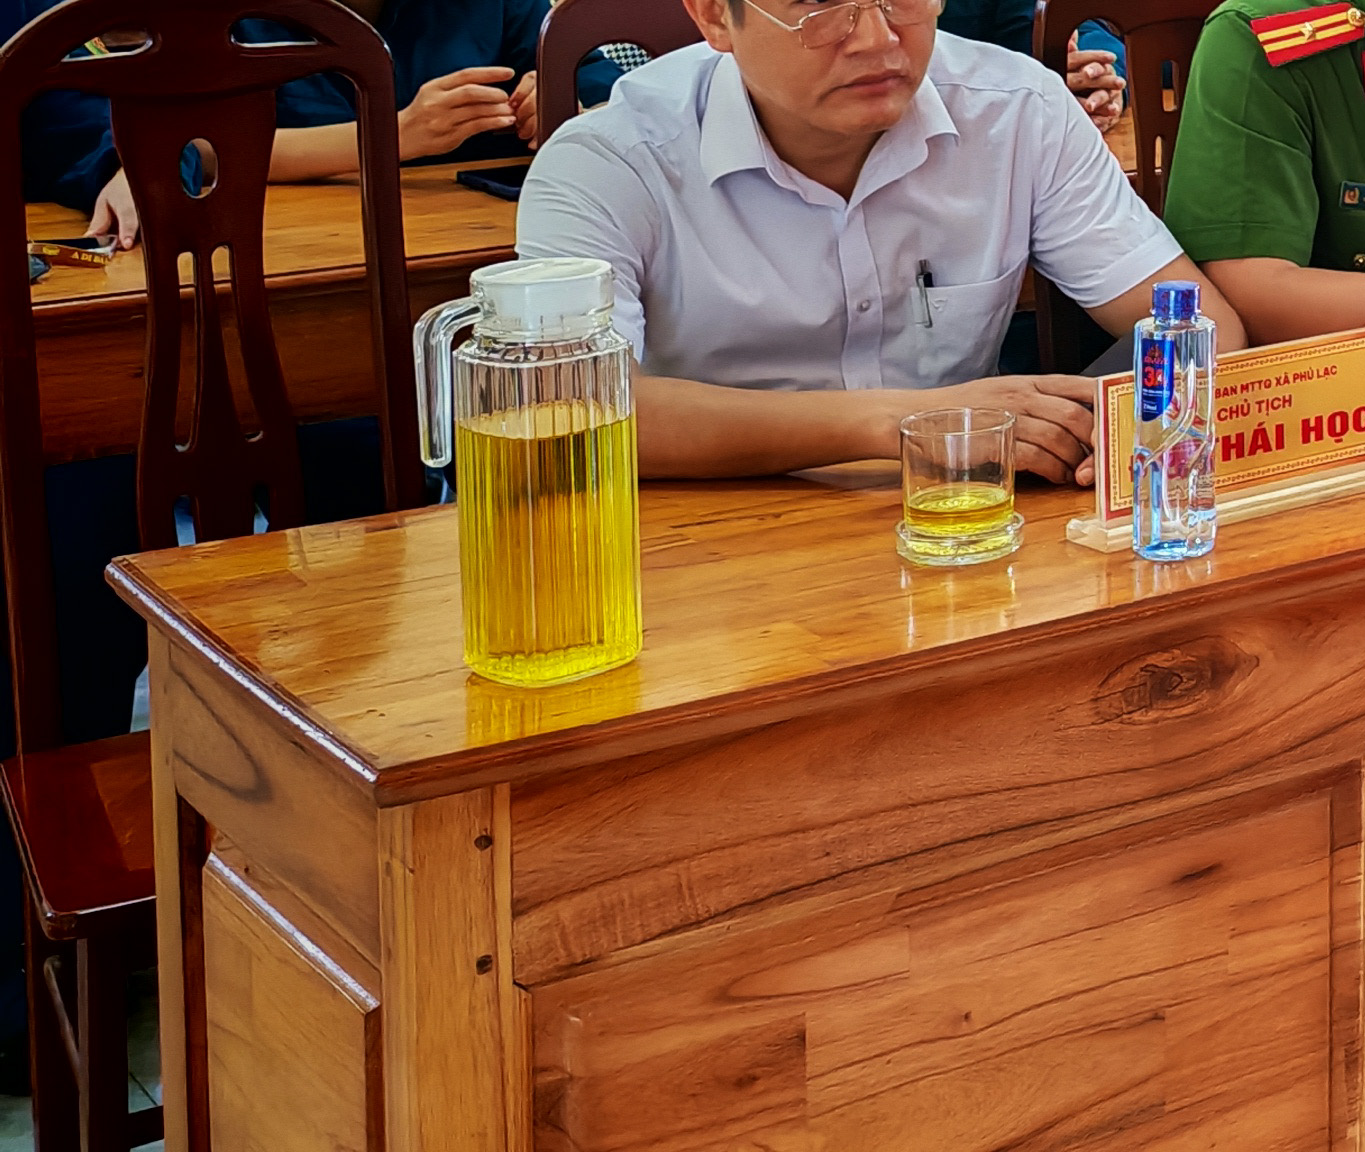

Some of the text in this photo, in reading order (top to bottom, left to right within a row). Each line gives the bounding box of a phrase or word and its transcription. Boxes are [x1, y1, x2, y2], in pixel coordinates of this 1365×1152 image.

[1316, 365, 1338, 380] LẠC
[1217, 394, 1293, 422] CHỦ TỊCH
[1215, 421, 1286, 462] HÁI
